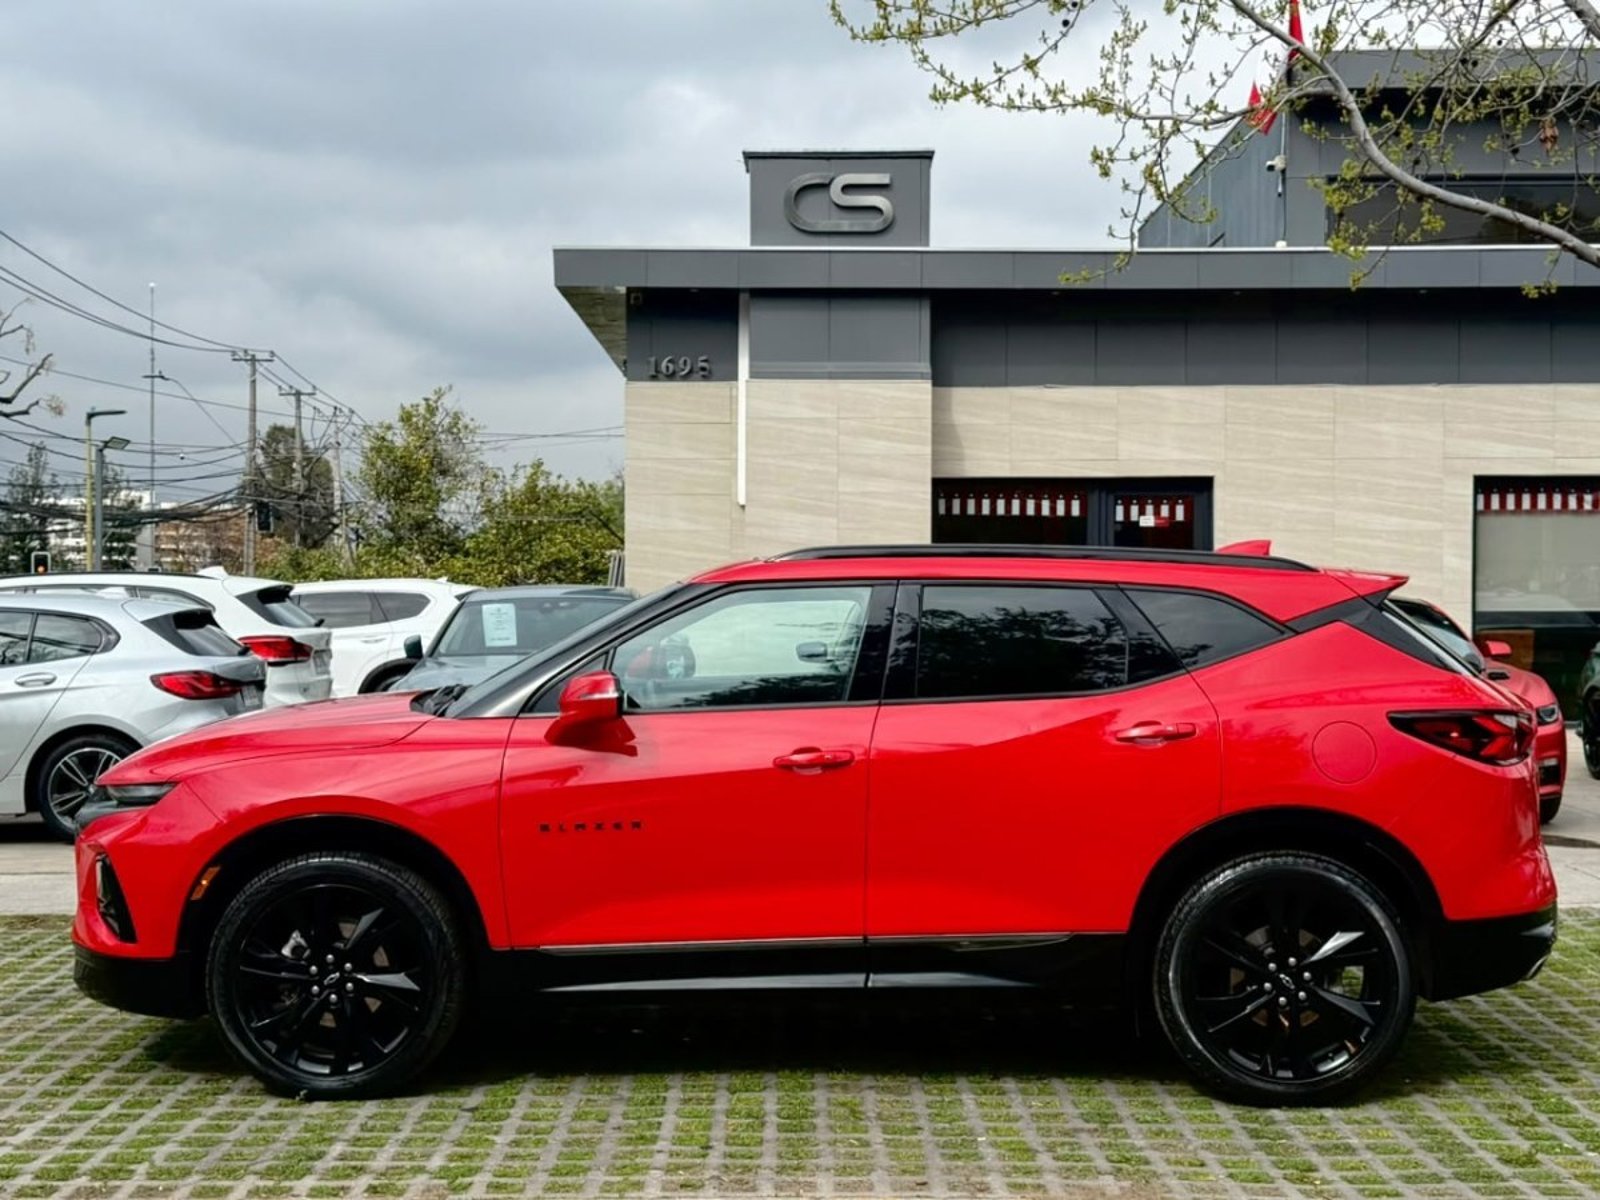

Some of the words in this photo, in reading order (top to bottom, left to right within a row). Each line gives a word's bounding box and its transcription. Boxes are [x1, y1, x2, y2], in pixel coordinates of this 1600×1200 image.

[784, 173, 894, 232] CS
[649, 356, 710, 376] 1695
[539, 820, 643, 833] BLAZER
